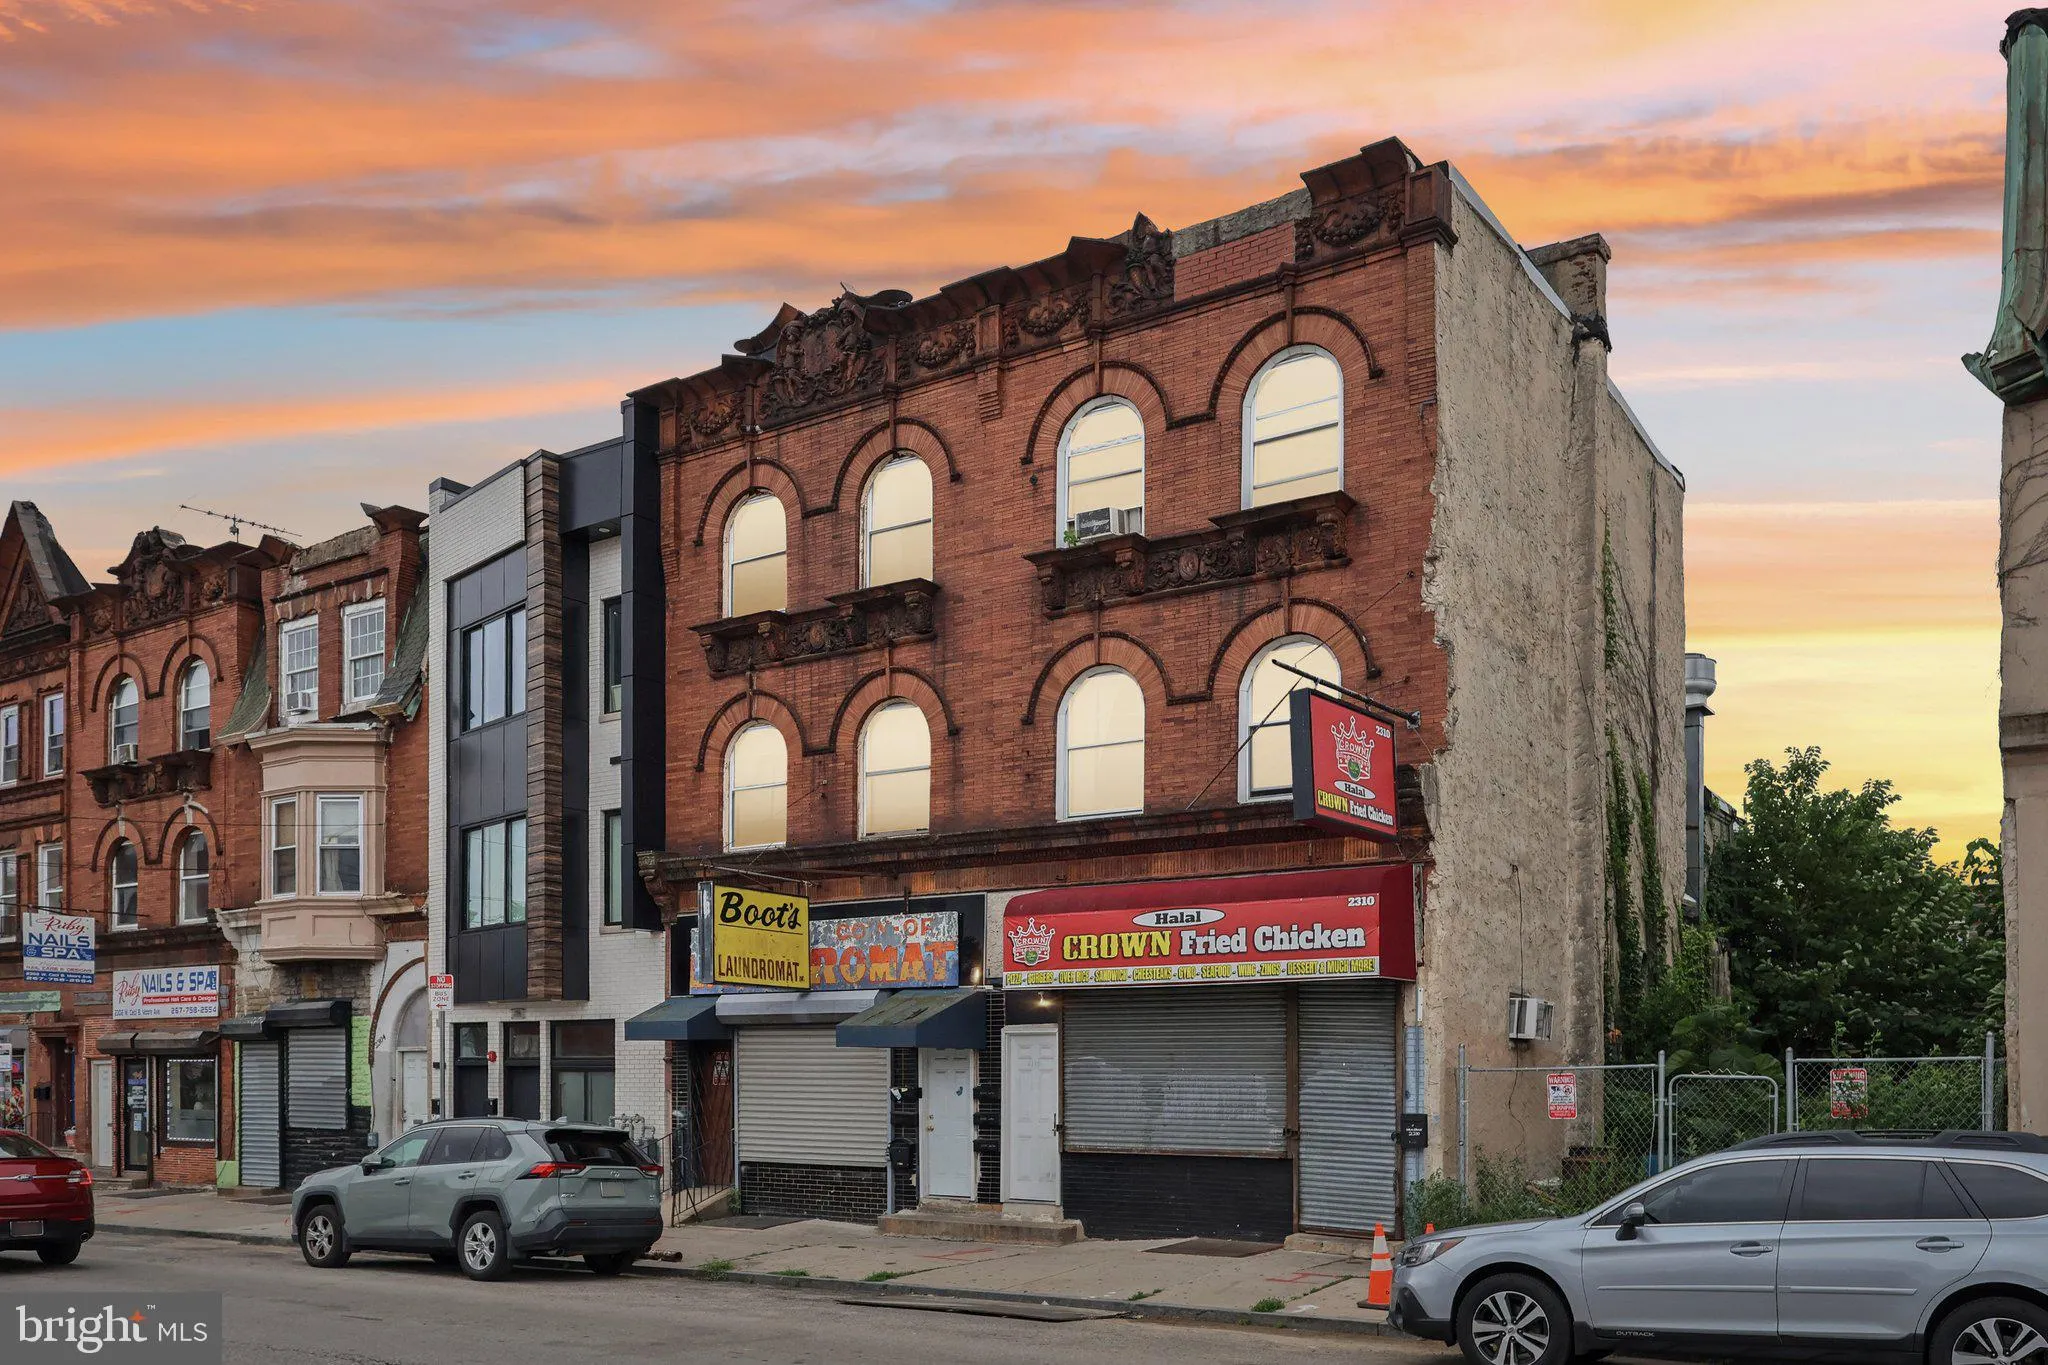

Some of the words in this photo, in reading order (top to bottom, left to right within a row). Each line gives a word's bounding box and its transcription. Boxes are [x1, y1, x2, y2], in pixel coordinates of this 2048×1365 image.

[1375, 725, 1391, 738] 2310
[1340, 739, 1368, 757] CROWN
[1344, 783, 1366, 797] Halal
[1317, 789, 1348, 813] CROWN
[1349, 800, 1367, 818] Fried
[1367, 805, 1394, 826] Chicken
[720, 892, 802, 929] Boot's
[1347, 895, 1375, 907] 2310
[36, 916, 85, 937] Ruby
[1155, 911, 1202, 925] Halal
[28, 932, 91, 948] NAILS
[1017, 936, 1048, 946] CROWN
[1062, 930, 1172, 961] CROWN
[1180, 927, 1248, 955] Fried
[1253, 923, 1366, 952] Chicken
[40, 946, 81, 960] SPA
[718, 955, 800, 982] LAUNDROMAT
[1027, 971, 1054, 985] BURGERS
[1095, 968, 1128, 982] SANDWICH
[1178, 966, 1197, 979] GYRO
[1201, 965, 1232, 978] SEAFOOD
[1287, 962, 1317, 975] DESSERT
[1319, 961, 1326, 974] &
[1326, 960, 1349, 974] MUCH
[1350, 958, 1376, 972] MORE!
[115, 972, 141, 1006] Ruby
[142, 973, 173, 993] NAILS
[176, 972, 185, 992] &
[189, 970, 212, 991] SPA
